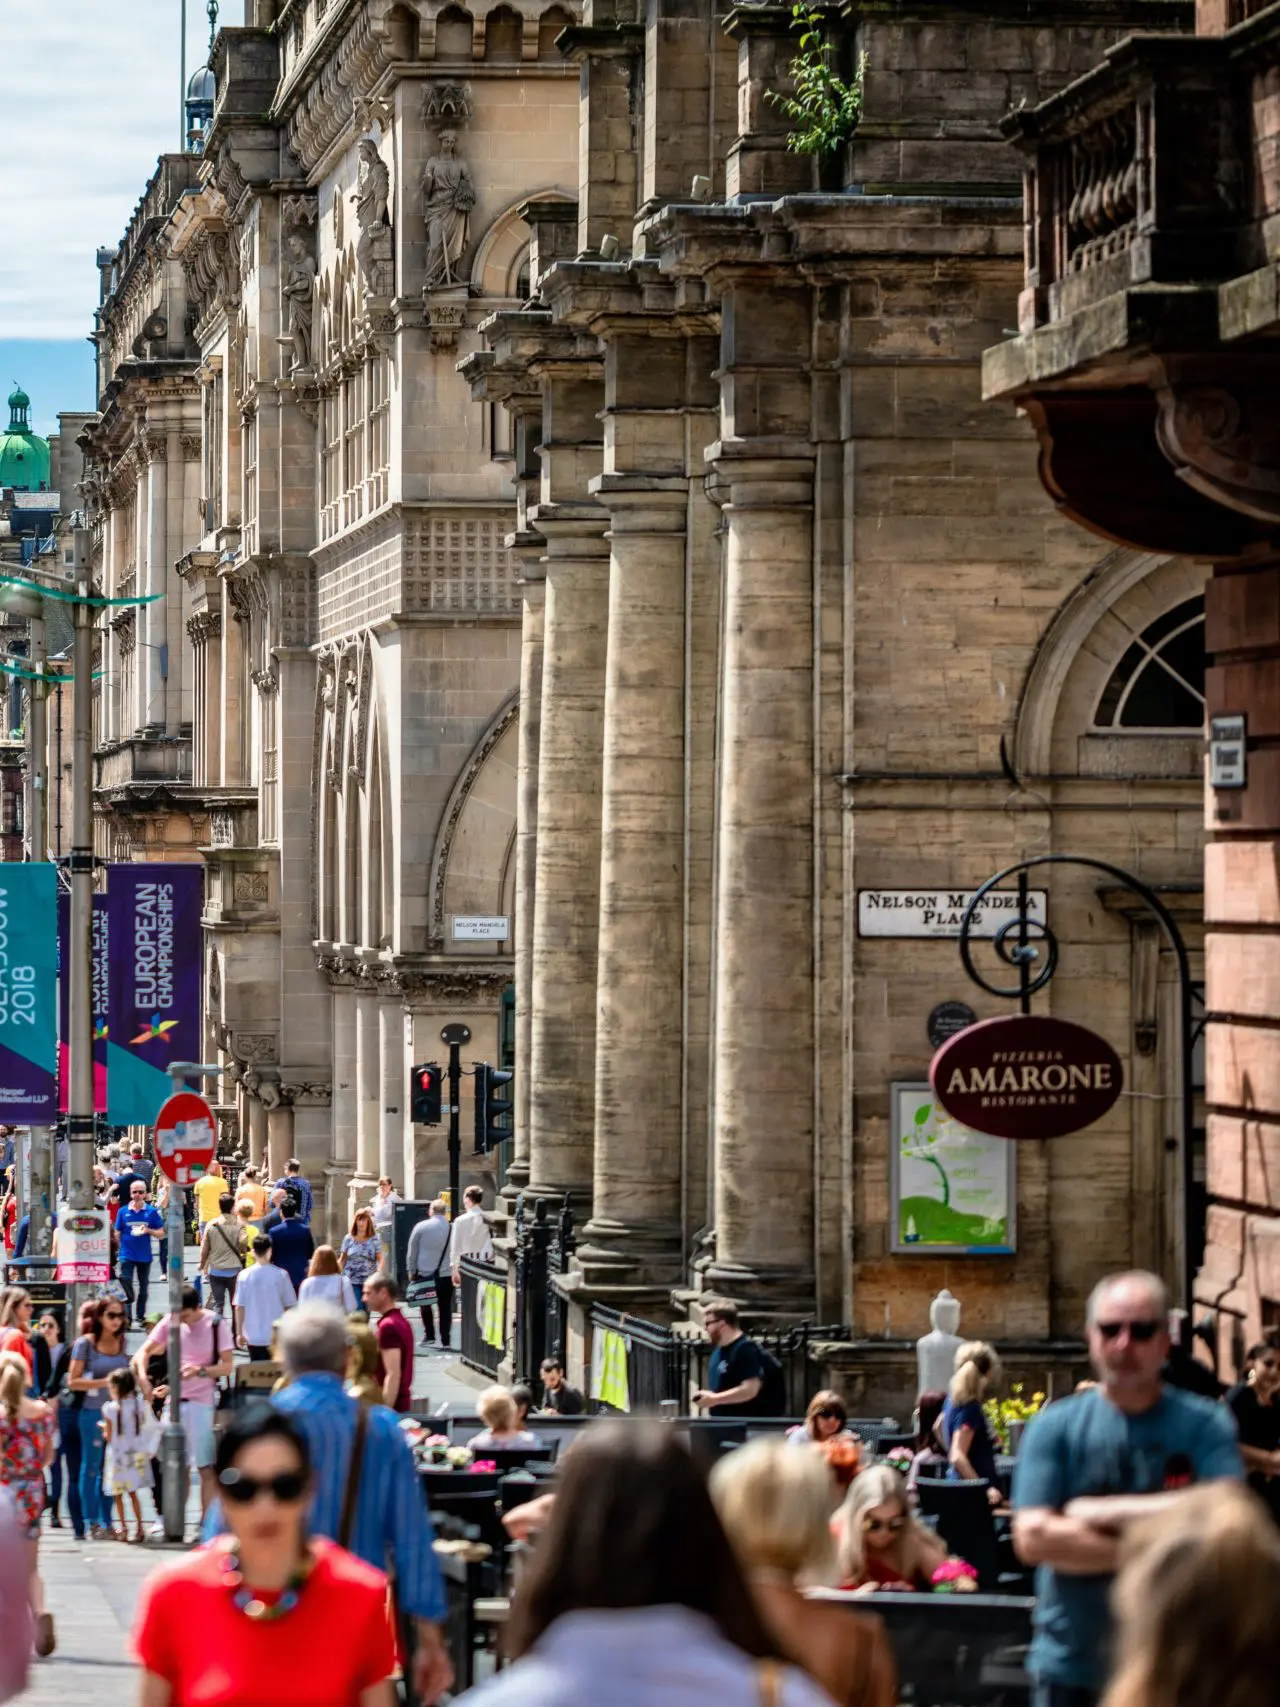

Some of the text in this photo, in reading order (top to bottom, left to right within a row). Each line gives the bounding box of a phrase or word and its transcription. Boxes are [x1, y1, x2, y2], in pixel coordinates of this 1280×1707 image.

[867, 894, 1037, 909] NELSON MNDELA
[135, 883, 157, 1009] EUROPEAN
[157, 883, 173, 1009] CHAMPIONSHIPS
[11, 965, 36, 1025] 2018
[992, 1051, 1064, 1063] PIZZERIA
[946, 1064, 1113, 1094] AMARONE
[981, 1094, 1077, 1107] RISTORANTE
